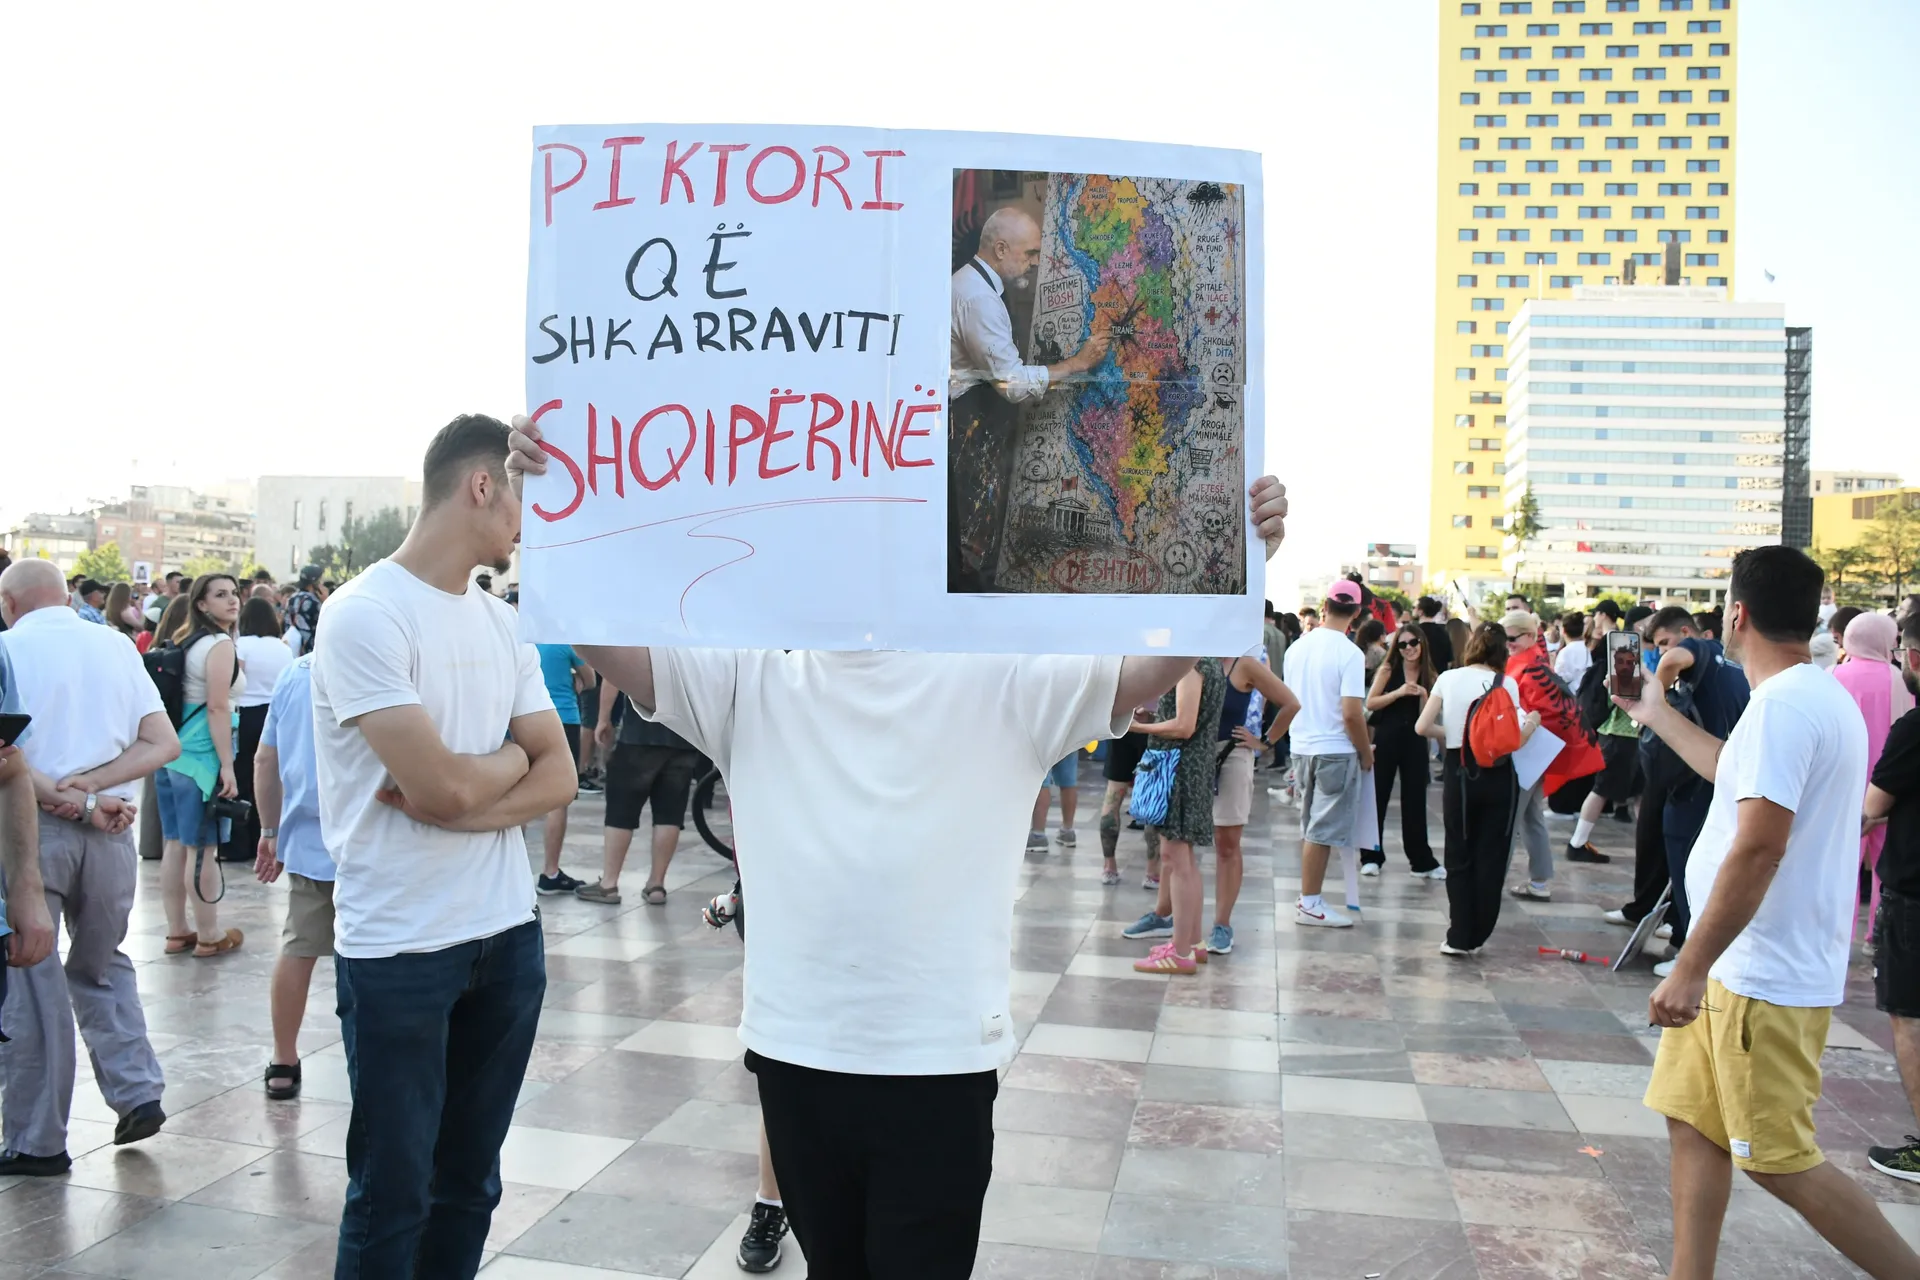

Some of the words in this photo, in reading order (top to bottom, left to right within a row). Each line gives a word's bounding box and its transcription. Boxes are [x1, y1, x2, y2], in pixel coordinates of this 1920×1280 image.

[537, 136, 906, 227] PIKTORI
[625, 222, 752, 302] QË
[1195, 244, 1205, 253] PA
[1206, 244, 1224, 253] FUND
[1047, 290, 1074, 308] BOSH
[1195, 294, 1204, 302] PA
[531, 306, 905, 365] SHKARRAVITI
[1200, 419, 1226, 430] RROGA
[531, 384, 942, 523] SHQIPËRINË
